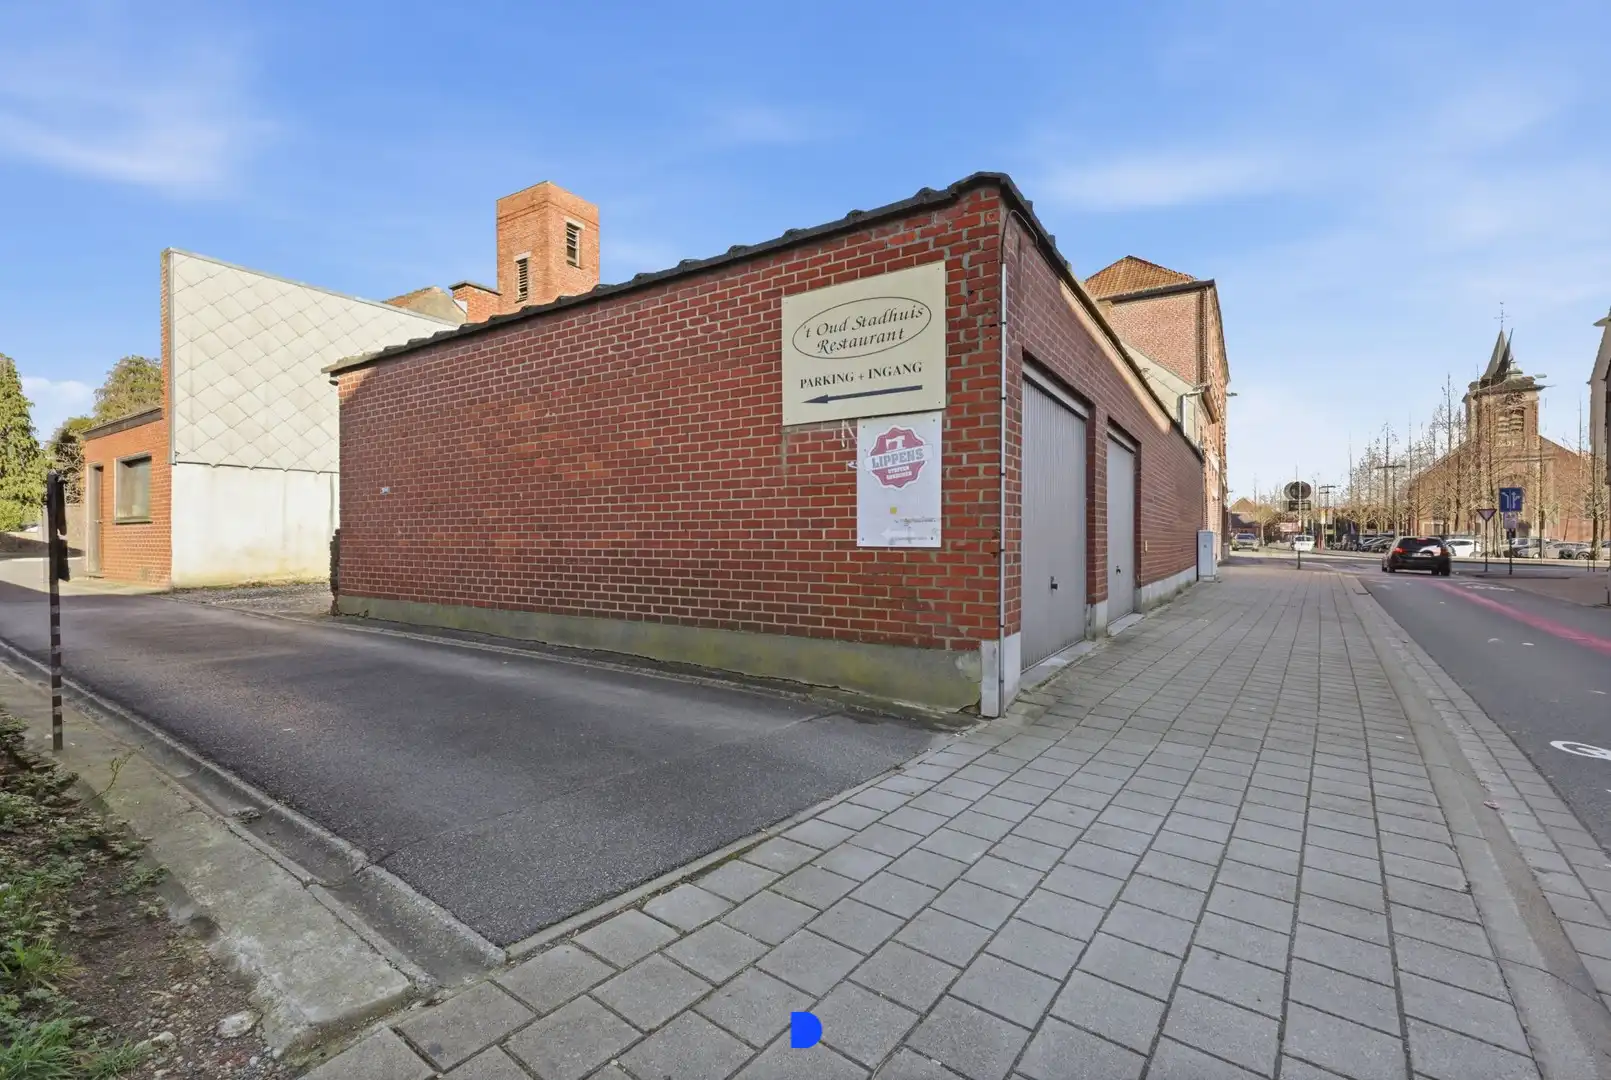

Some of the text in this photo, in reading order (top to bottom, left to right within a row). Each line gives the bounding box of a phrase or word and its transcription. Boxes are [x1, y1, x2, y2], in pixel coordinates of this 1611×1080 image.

[816, 316, 850, 336] Oud
[851, 304, 925, 331] Stadhuis
[817, 328, 905, 355] Restaurant
[800, 371, 855, 389] PARKING
[868, 361, 923, 379] INGANG
[872, 448, 925, 468] LIPPENS
